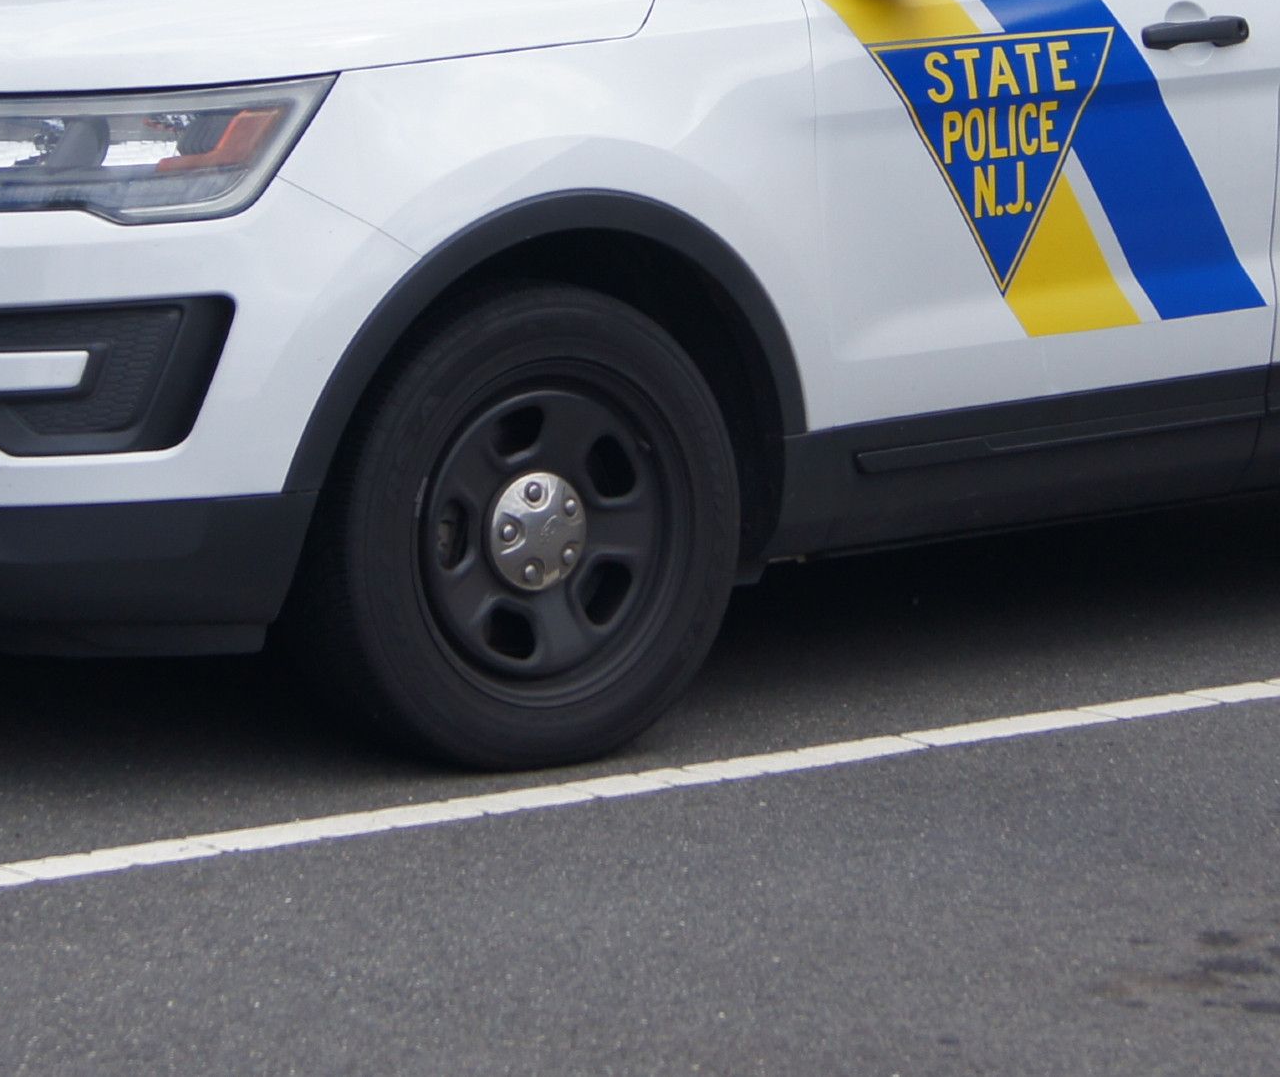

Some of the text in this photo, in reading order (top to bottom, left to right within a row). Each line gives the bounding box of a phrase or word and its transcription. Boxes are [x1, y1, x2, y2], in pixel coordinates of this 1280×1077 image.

[924, 40, 1076, 104] STATE
[943, 100, 1060, 164] POLICE
[973, 161, 1033, 218] N.J.
